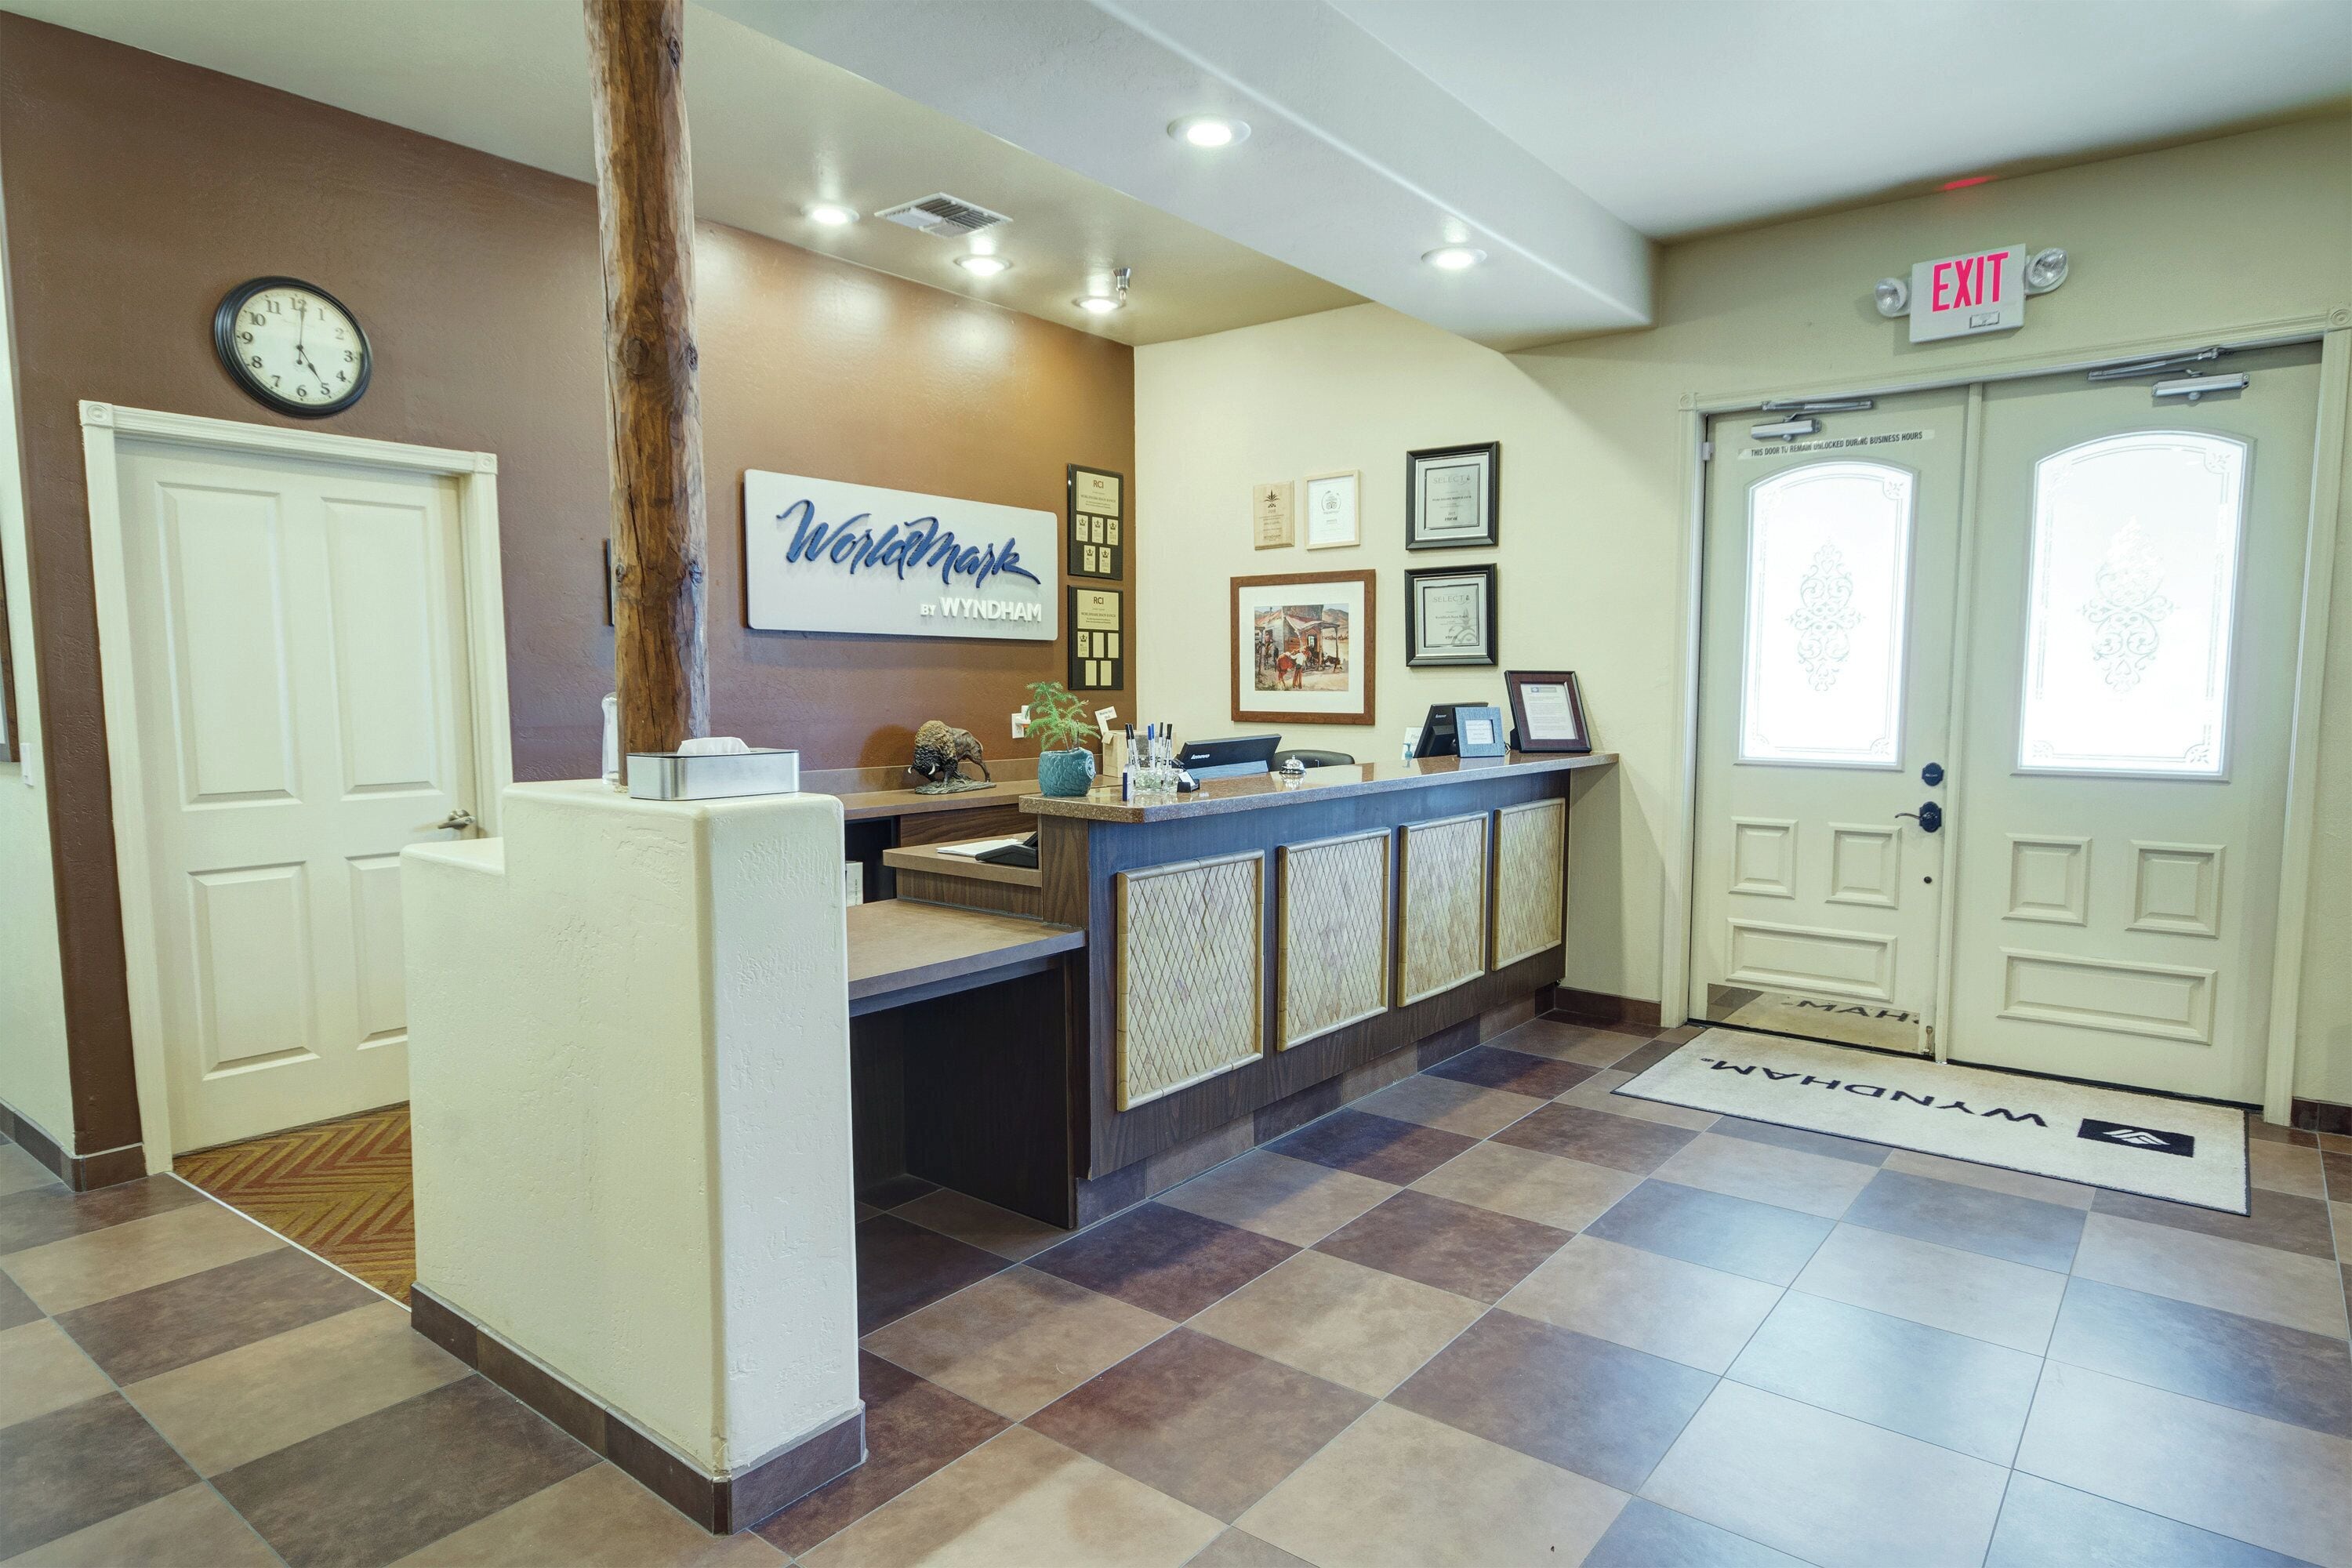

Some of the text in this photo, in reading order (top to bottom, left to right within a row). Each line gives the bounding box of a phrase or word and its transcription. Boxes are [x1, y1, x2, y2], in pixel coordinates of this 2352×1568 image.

[1933, 251, 2009, 312] EXIT
[266, 299, 281, 314] 11
[289, 296, 307, 312] 12
[249, 311, 266, 326] 10
[318, 307, 325, 321] 1
[241, 332, 253, 344] 9
[335, 328, 344, 340] 2
[252, 355, 263, 368] 8
[344, 350, 353, 362] 3
[271, 375, 281, 387] 7
[336, 370, 347, 382] 4
[296, 384, 307, 397] 6
[321, 383, 330, 395] 5
[1765, 446, 1780, 455] DOOR
[1790, 443, 1812, 452] REMAIN
[1813, 440, 1844, 450] UNLOCKED
[1846, 437, 1867, 447] DURING
[1870, 434, 1900, 445] BUSINESS
[1901, 431, 1922, 441] HOURS
[1093, 480, 1104, 488] RCI
[776, 499, 1041, 588] WorldMark
[920, 596, 1042, 622] BY WYNDHAM
[1710, 1060, 2049, 1127] WYNDHAM
